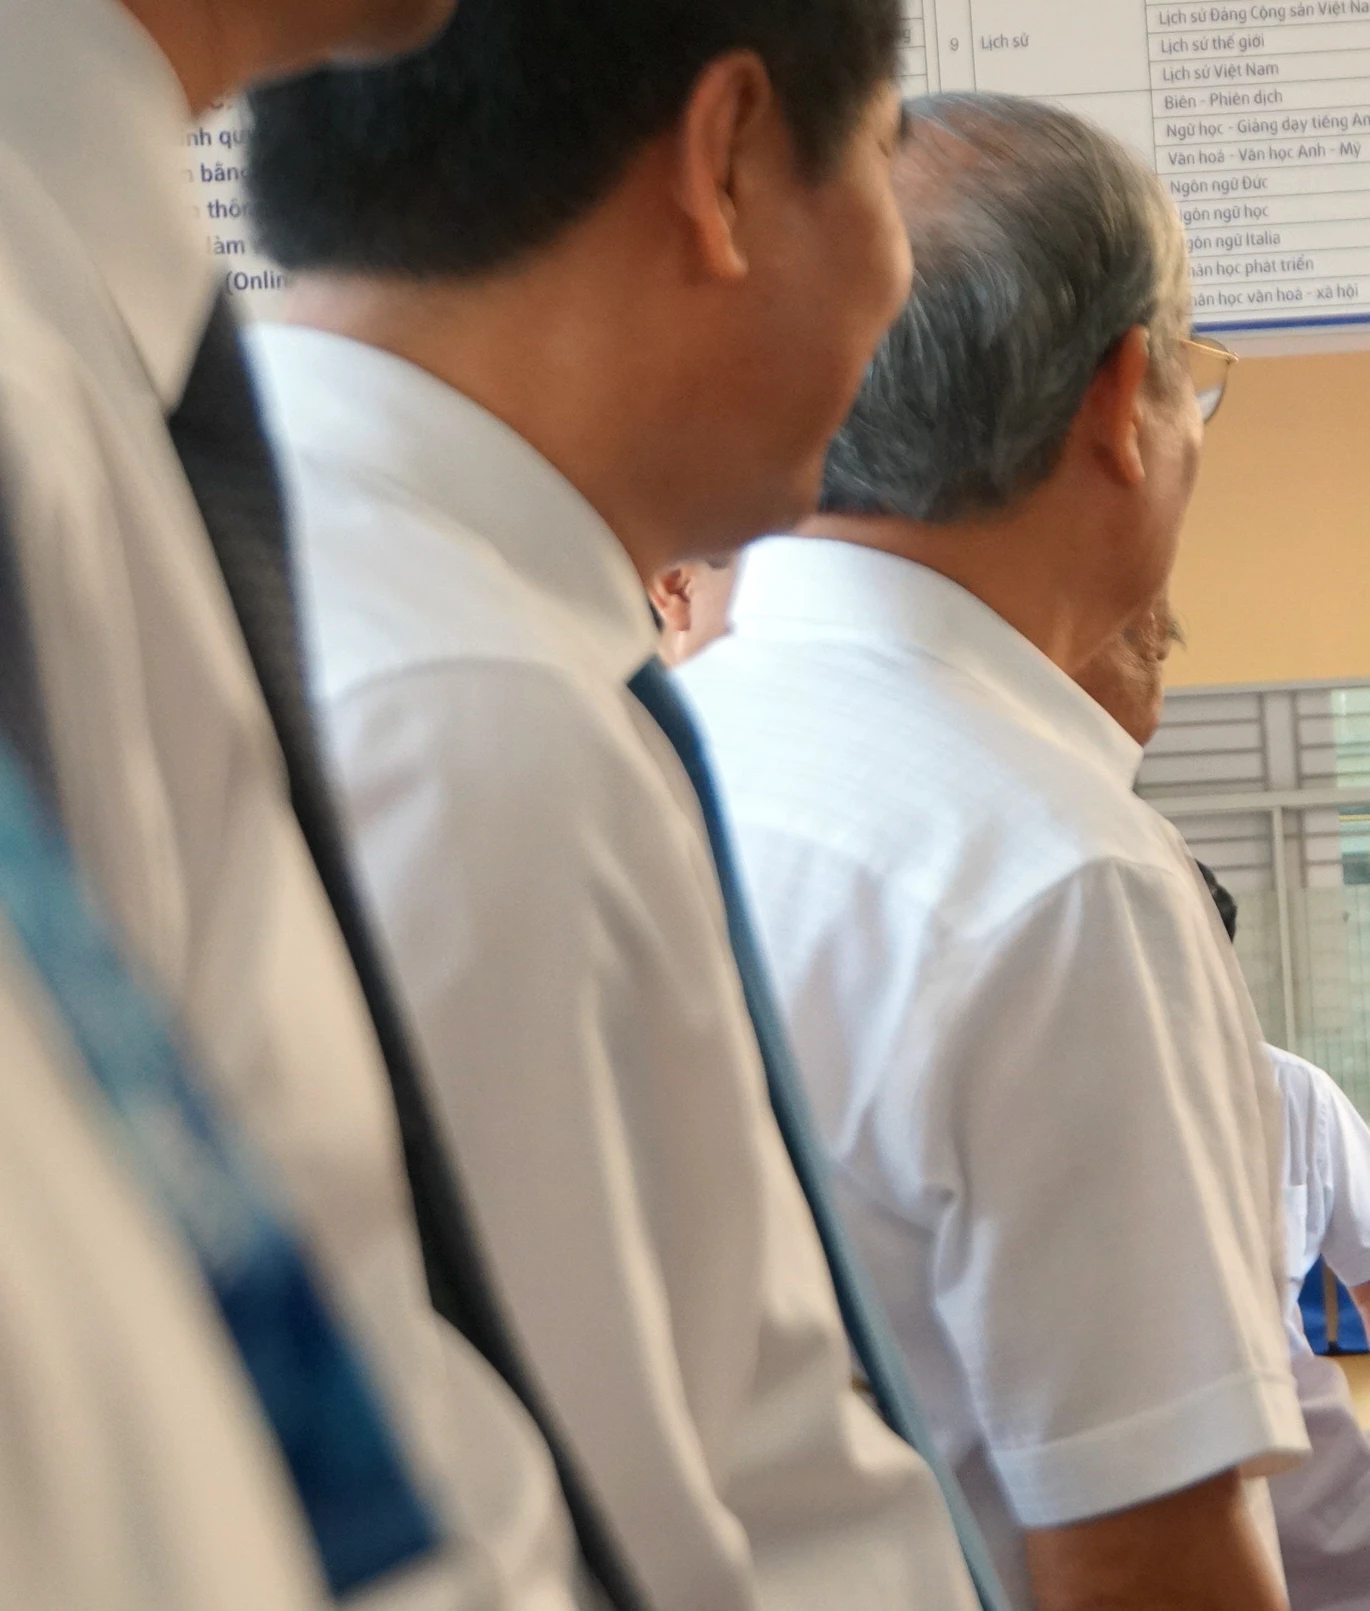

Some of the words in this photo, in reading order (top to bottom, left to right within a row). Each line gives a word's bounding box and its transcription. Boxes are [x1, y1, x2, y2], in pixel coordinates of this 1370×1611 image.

[1159, 10, 1186, 27] Lịch
[1191, 8, 1207, 23] sử
[1211, 7, 1247, 23] Đảng
[1251, 5, 1286, 21] Cộng
[1290, 2, 1314, 17] sản
[1318, 0, 1346, 17] Việt
[950, 38, 959, 52] 9
[981, 34, 1008, 50] Lịch
[1013, 32, 1029, 48] sử
[1160, 38, 1188, 55] Lịch
[1192, 36, 1209, 51] sử
[1212, 33, 1234, 50] thế
[1239, 34, 1265, 51] giới
[1162, 66, 1190, 83] Lịch
[1194, 65, 1210, 79] sử
[1214, 64, 1242, 80] Việt
[1245, 64, 1279, 77] Nam
[1165, 94, 1196, 110] Biên
[1210, 91, 1250, 107] Phiên
[1254, 89, 1283, 106] dịch
[1167, 122, 1195, 139] Ngữ
[1199, 121, 1224, 137] học
[1237, 118, 1278, 134] Giảng
[1282, 117, 1308, 133] dạy
[1312, 112, 1348, 131] tiếng
[1168, 151, 1195, 165] Văn
[1199, 149, 1225, 164] hoá
[1238, 147, 1265, 161] Văn
[1269, 146, 1294, 162] học
[1298, 143, 1326, 158] Anh
[1340, 141, 1362, 158] Mỹ
[1171, 179, 1208, 196] Ngôn
[1212, 176, 1238, 194] ngữ
[1242, 175, 1269, 190] Đức
[1180, 207, 1210, 225] gôn
[1213, 205, 1240, 222] ngữ
[1244, 204, 1269, 220] học
[1187, 235, 1212, 252] gôn
[1216, 233, 1242, 251] ngữ
[1246, 232, 1281, 246] Italia
[1217, 262, 1240, 278] học
[1245, 259, 1277, 277] phát
[1281, 255, 1314, 272] triển
[1219, 290, 1242, 306] học
[1247, 288, 1273, 303] văn
[1277, 286, 1303, 301] hoá
[1317, 285, 1333, 299] xã
[1337, 284, 1359, 300] hội
